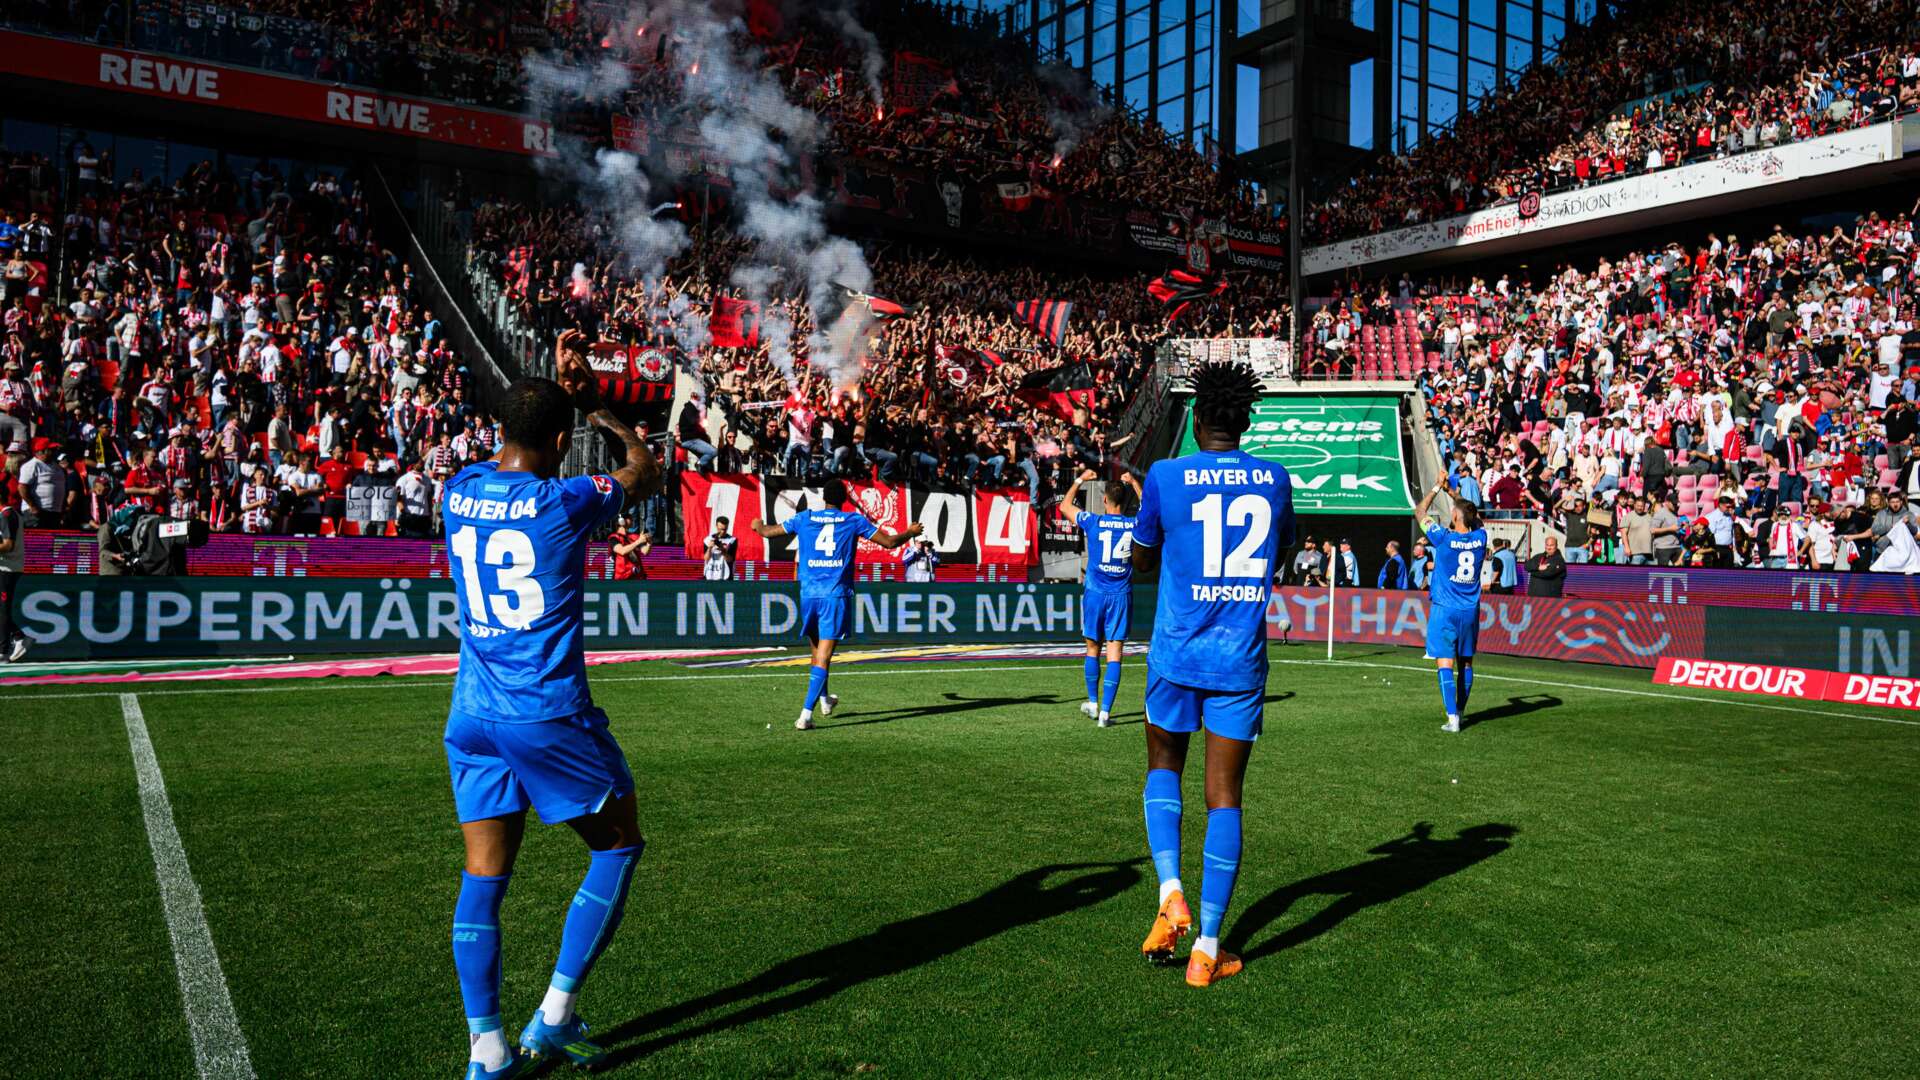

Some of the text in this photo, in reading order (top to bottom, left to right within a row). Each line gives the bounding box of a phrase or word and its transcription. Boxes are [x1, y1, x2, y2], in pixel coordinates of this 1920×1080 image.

[100, 53, 219, 99] REWE
[326, 91, 429, 132] REWE
[1248, 419, 1383, 432] stens
[1184, 469, 1274, 485] BAYER 04
[1288, 473, 1392, 492] VK
[450, 492, 538, 520] BAYER 04
[815, 523, 836, 557] 4
[1099, 520, 1123, 529] BAYER
[1192, 493, 1272, 578] 12
[1099, 530, 1132, 564] 14
[1450, 540, 1472, 550] BAYER
[451, 525, 545, 630] 13
[1457, 551, 1475, 580] 8
[677, 592, 735, 635] IN
[760, 593, 955, 635] DNER
[975, 584, 1084, 633] NÄH
[1838, 626, 1910, 677] IN
[1669, 659, 1806, 696] DERTOUR
